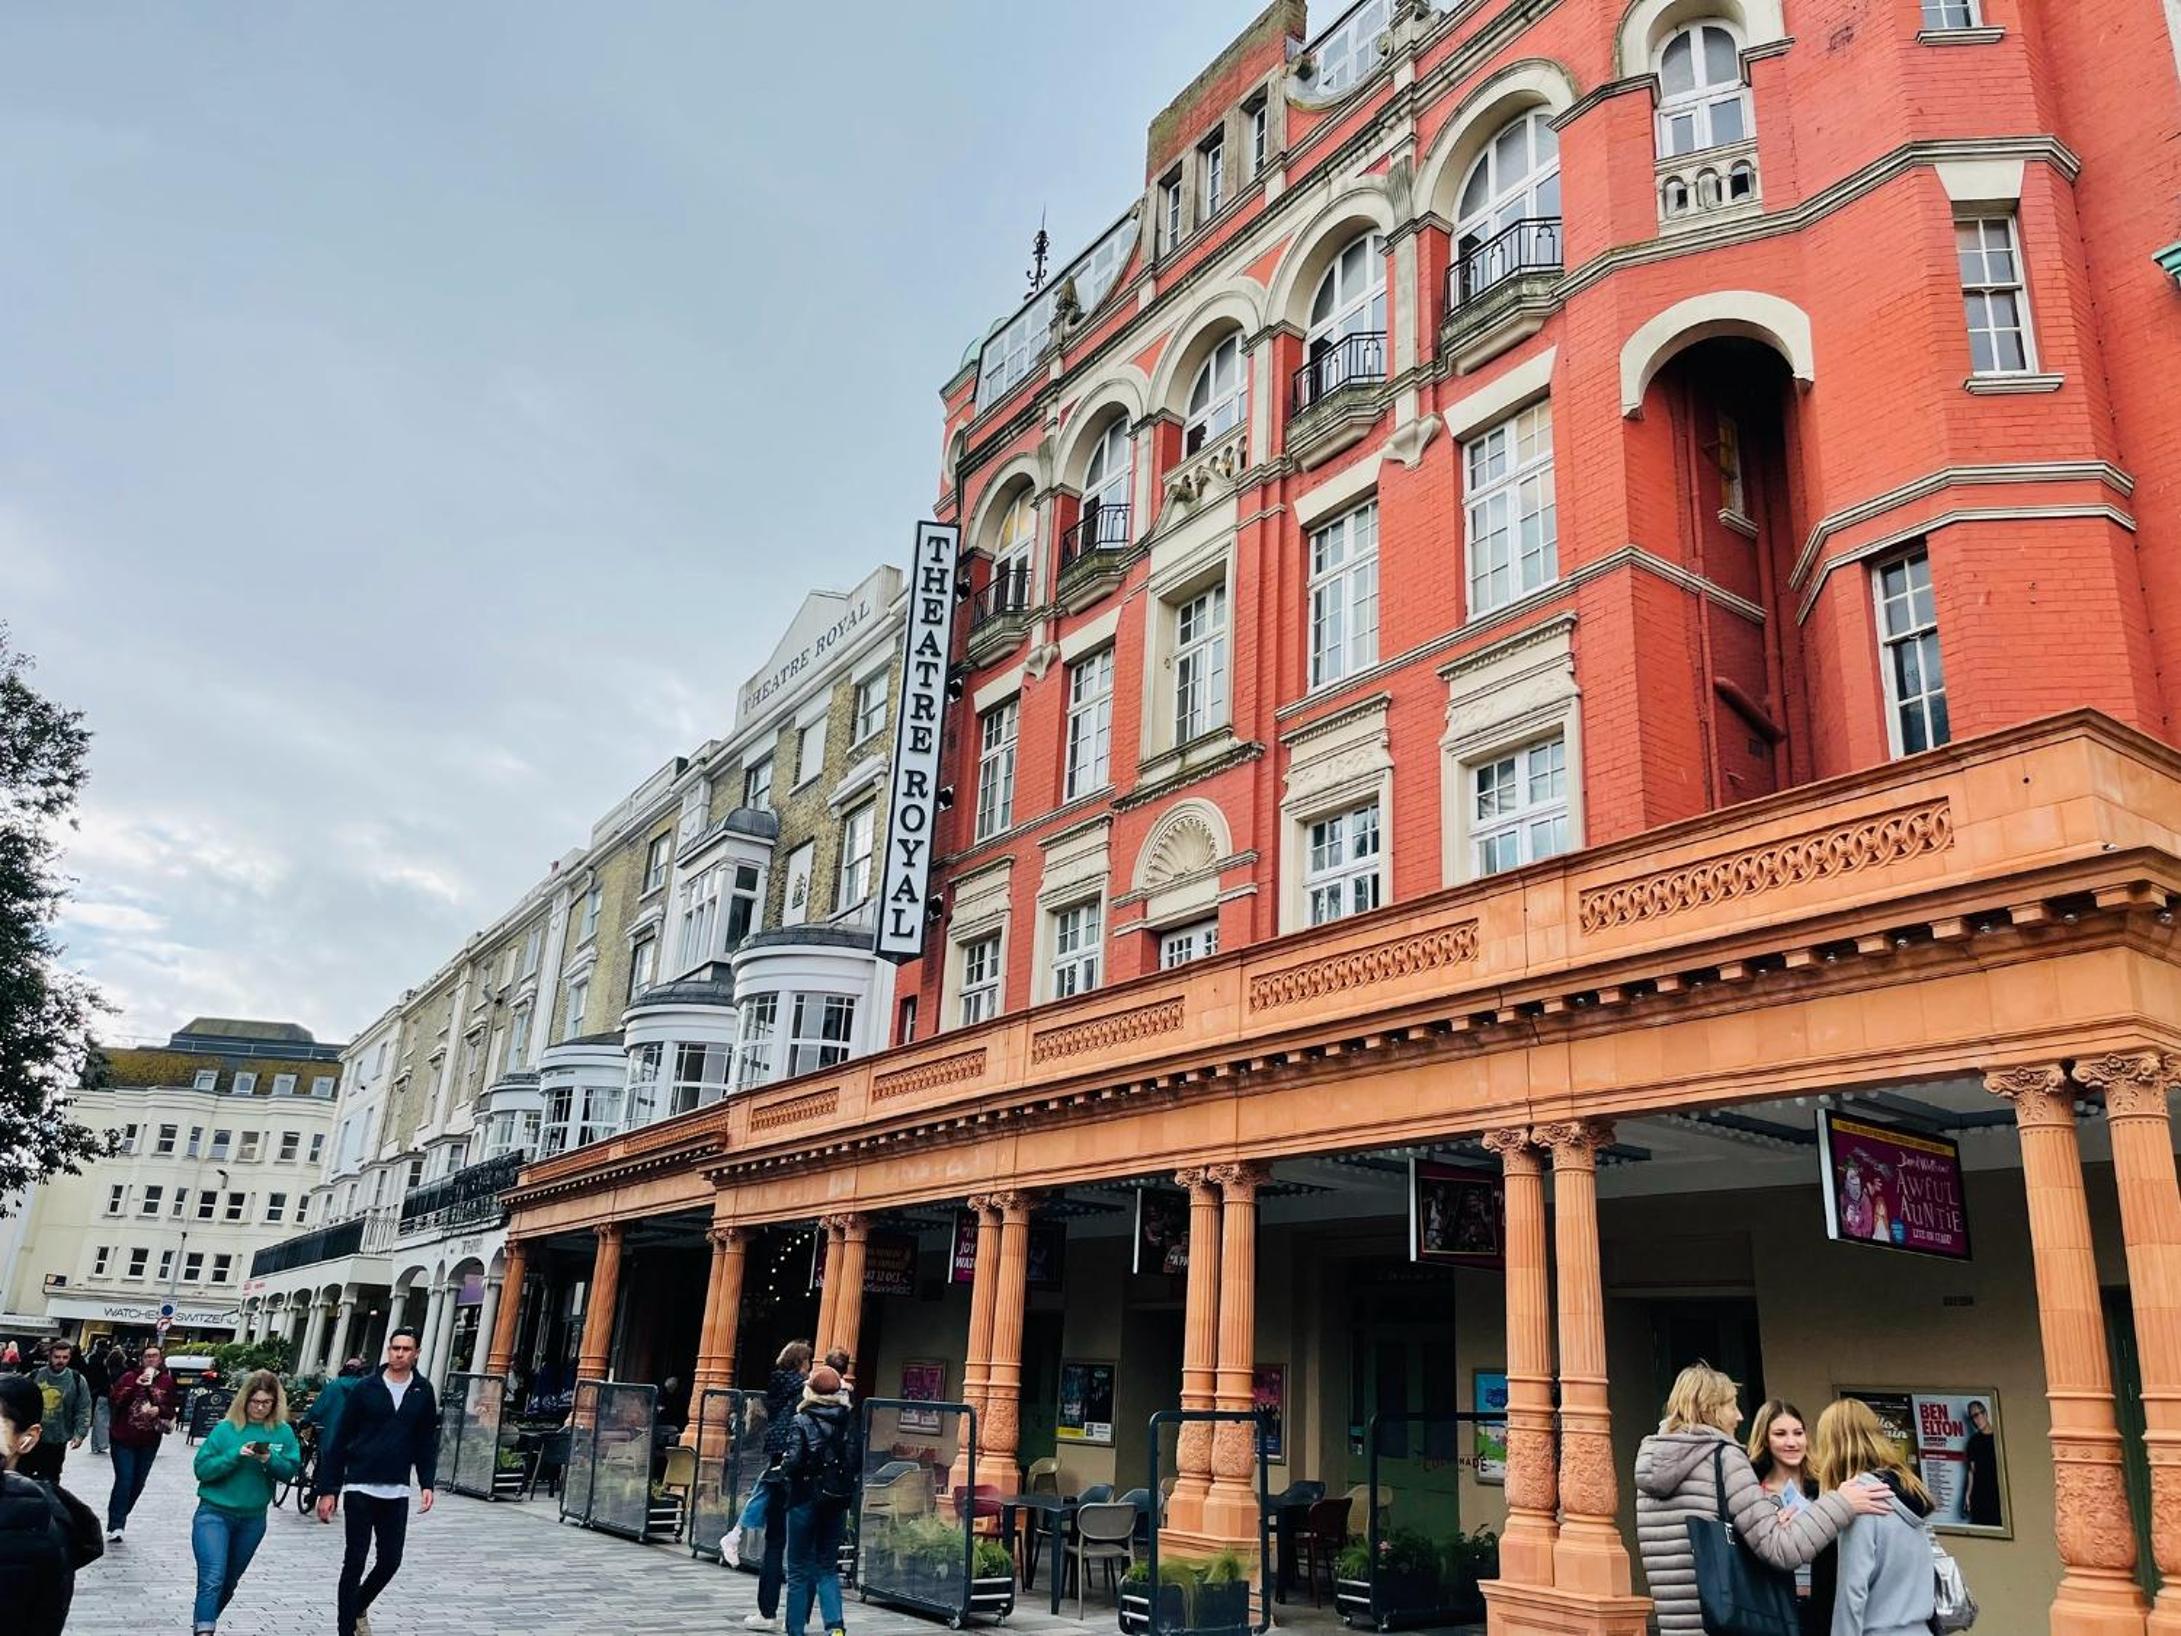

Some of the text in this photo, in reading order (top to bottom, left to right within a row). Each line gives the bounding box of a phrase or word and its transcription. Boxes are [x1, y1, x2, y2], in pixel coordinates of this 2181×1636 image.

[742, 600, 871, 715] THEATRE ROYAL
[889, 535, 950, 939] THEATRE ROYAL
[955, 1256, 975, 1269] WAT
[1919, 1403, 1949, 1420] BEN
[1921, 1420, 1964, 1437] ELTON
